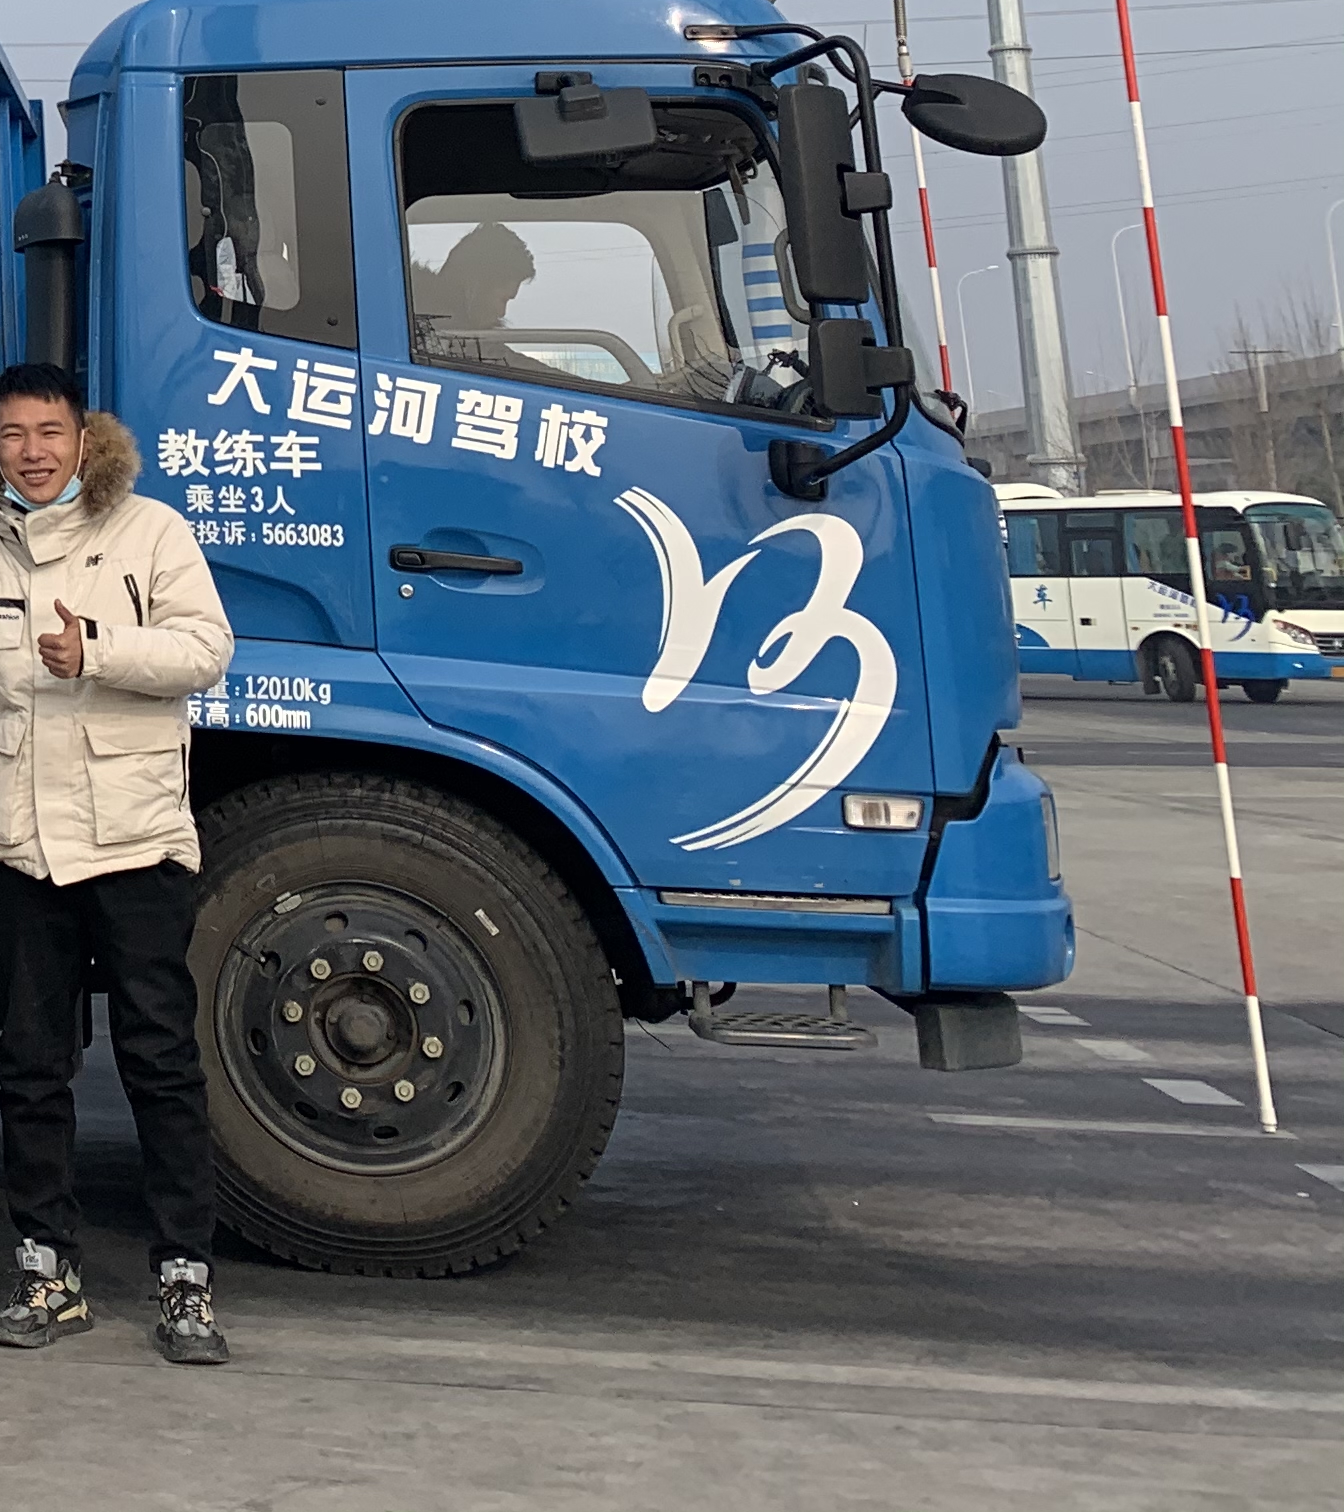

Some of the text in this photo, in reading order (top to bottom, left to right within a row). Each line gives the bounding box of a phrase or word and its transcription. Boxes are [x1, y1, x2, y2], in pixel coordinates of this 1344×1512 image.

[207, 347, 609, 477] 大运河驾校
[157, 428, 323, 478] 教练车
[185, 484, 296, 516] 乘坐3人
[1032, 583, 1053, 612] 车
